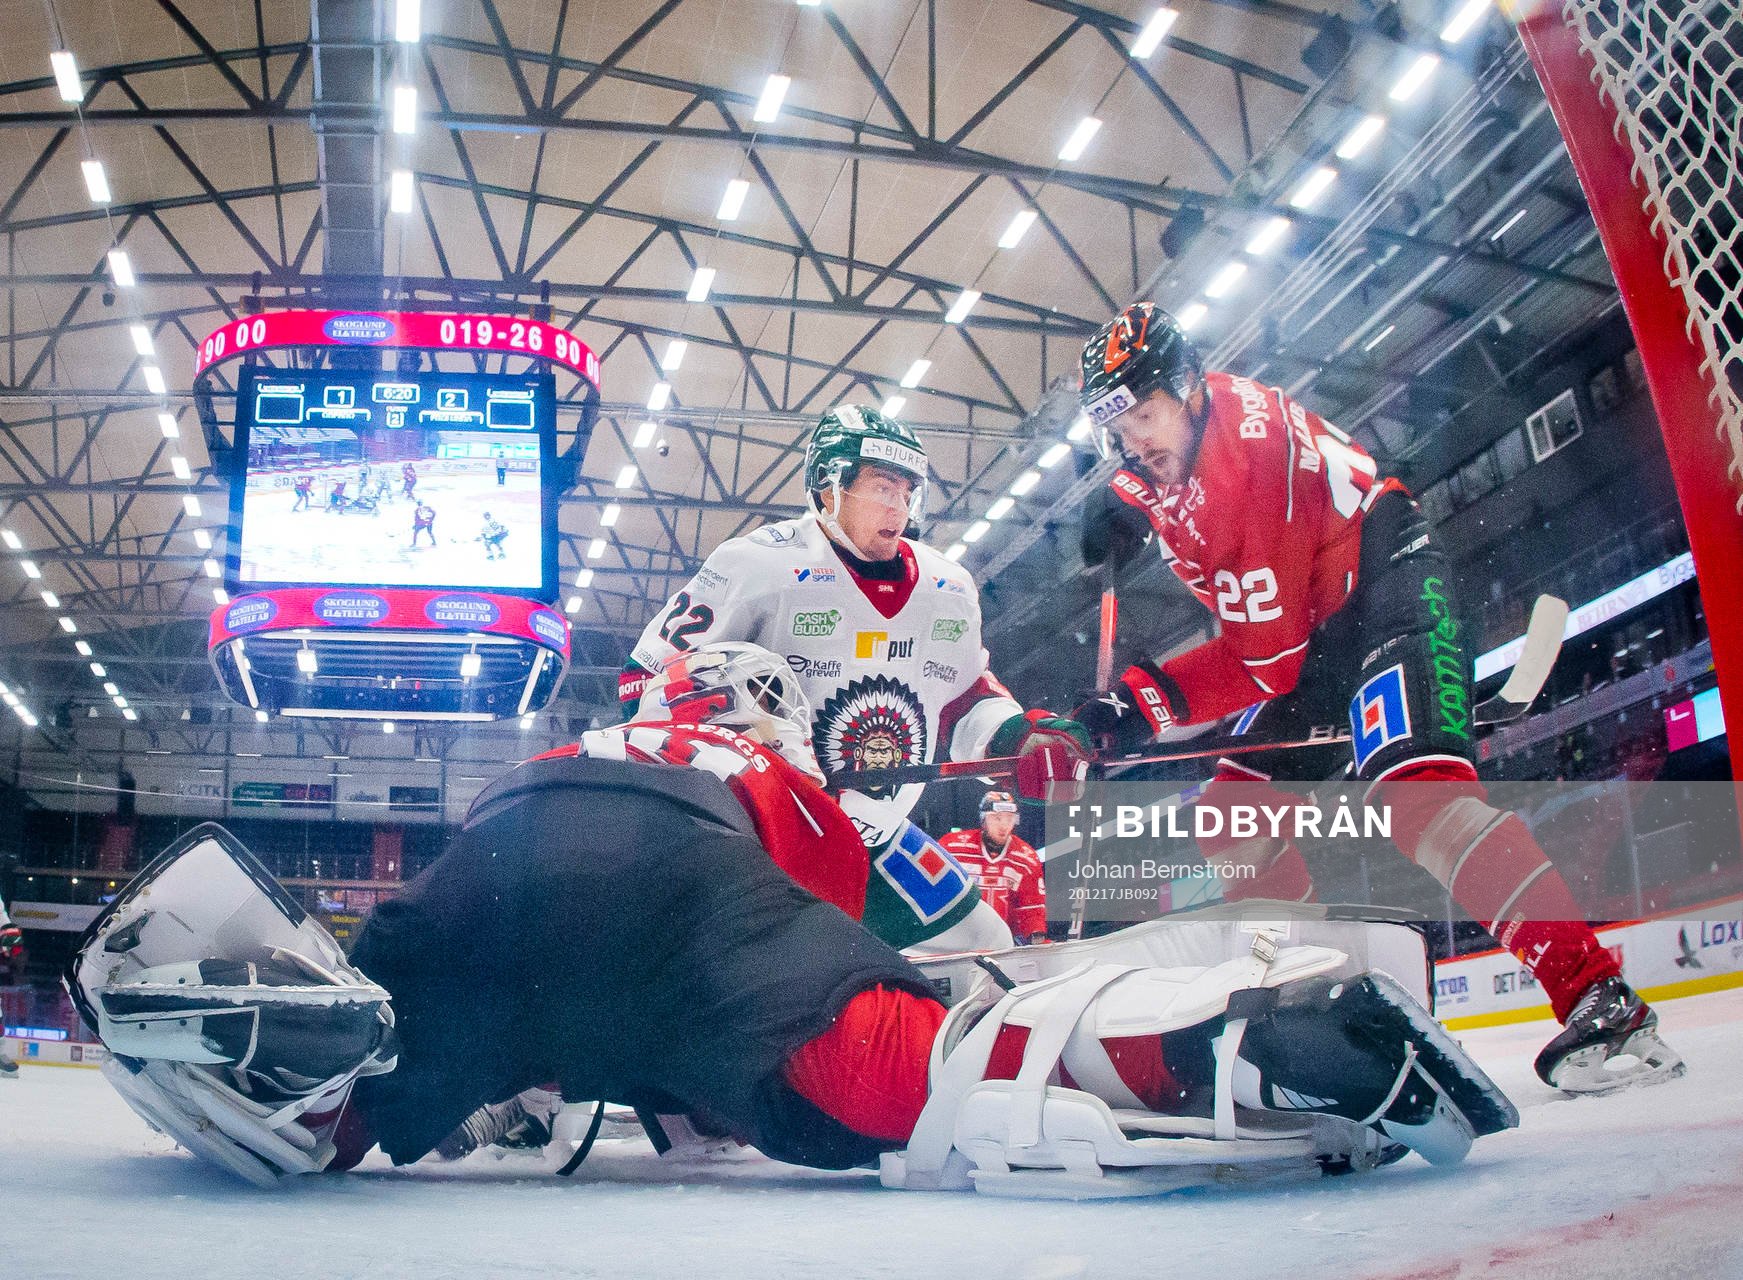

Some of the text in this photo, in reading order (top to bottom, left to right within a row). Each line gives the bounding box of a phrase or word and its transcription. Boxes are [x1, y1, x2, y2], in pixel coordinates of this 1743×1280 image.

[333, 320, 386, 329] SKOGLUND
[205, 332, 226, 363] 90
[236, 319, 266, 348] 00
[440, 319, 543, 351] 019-26
[555, 333, 580, 365] 90
[337, 390, 345, 405] 1
[383, 387, 413, 400] 6:20
[444, 394, 456, 408] 2
[390, 414, 399, 424] 2
[812, 574, 836, 583] SPORT
[878, 585, 895, 593] SHL
[1214, 567, 1283, 623] 22
[323, 599, 380, 608] SKOGLUND
[435, 601, 491, 611] SKOGLUND
[366, 610, 380, 618] AB
[478, 613, 492, 623] AB
[794, 613, 827, 625] CASH
[658, 591, 715, 652] 22
[793, 624, 836, 636] BUDDY
[813, 660, 842, 670] Kaffe
[806, 666, 841, 678] greven
